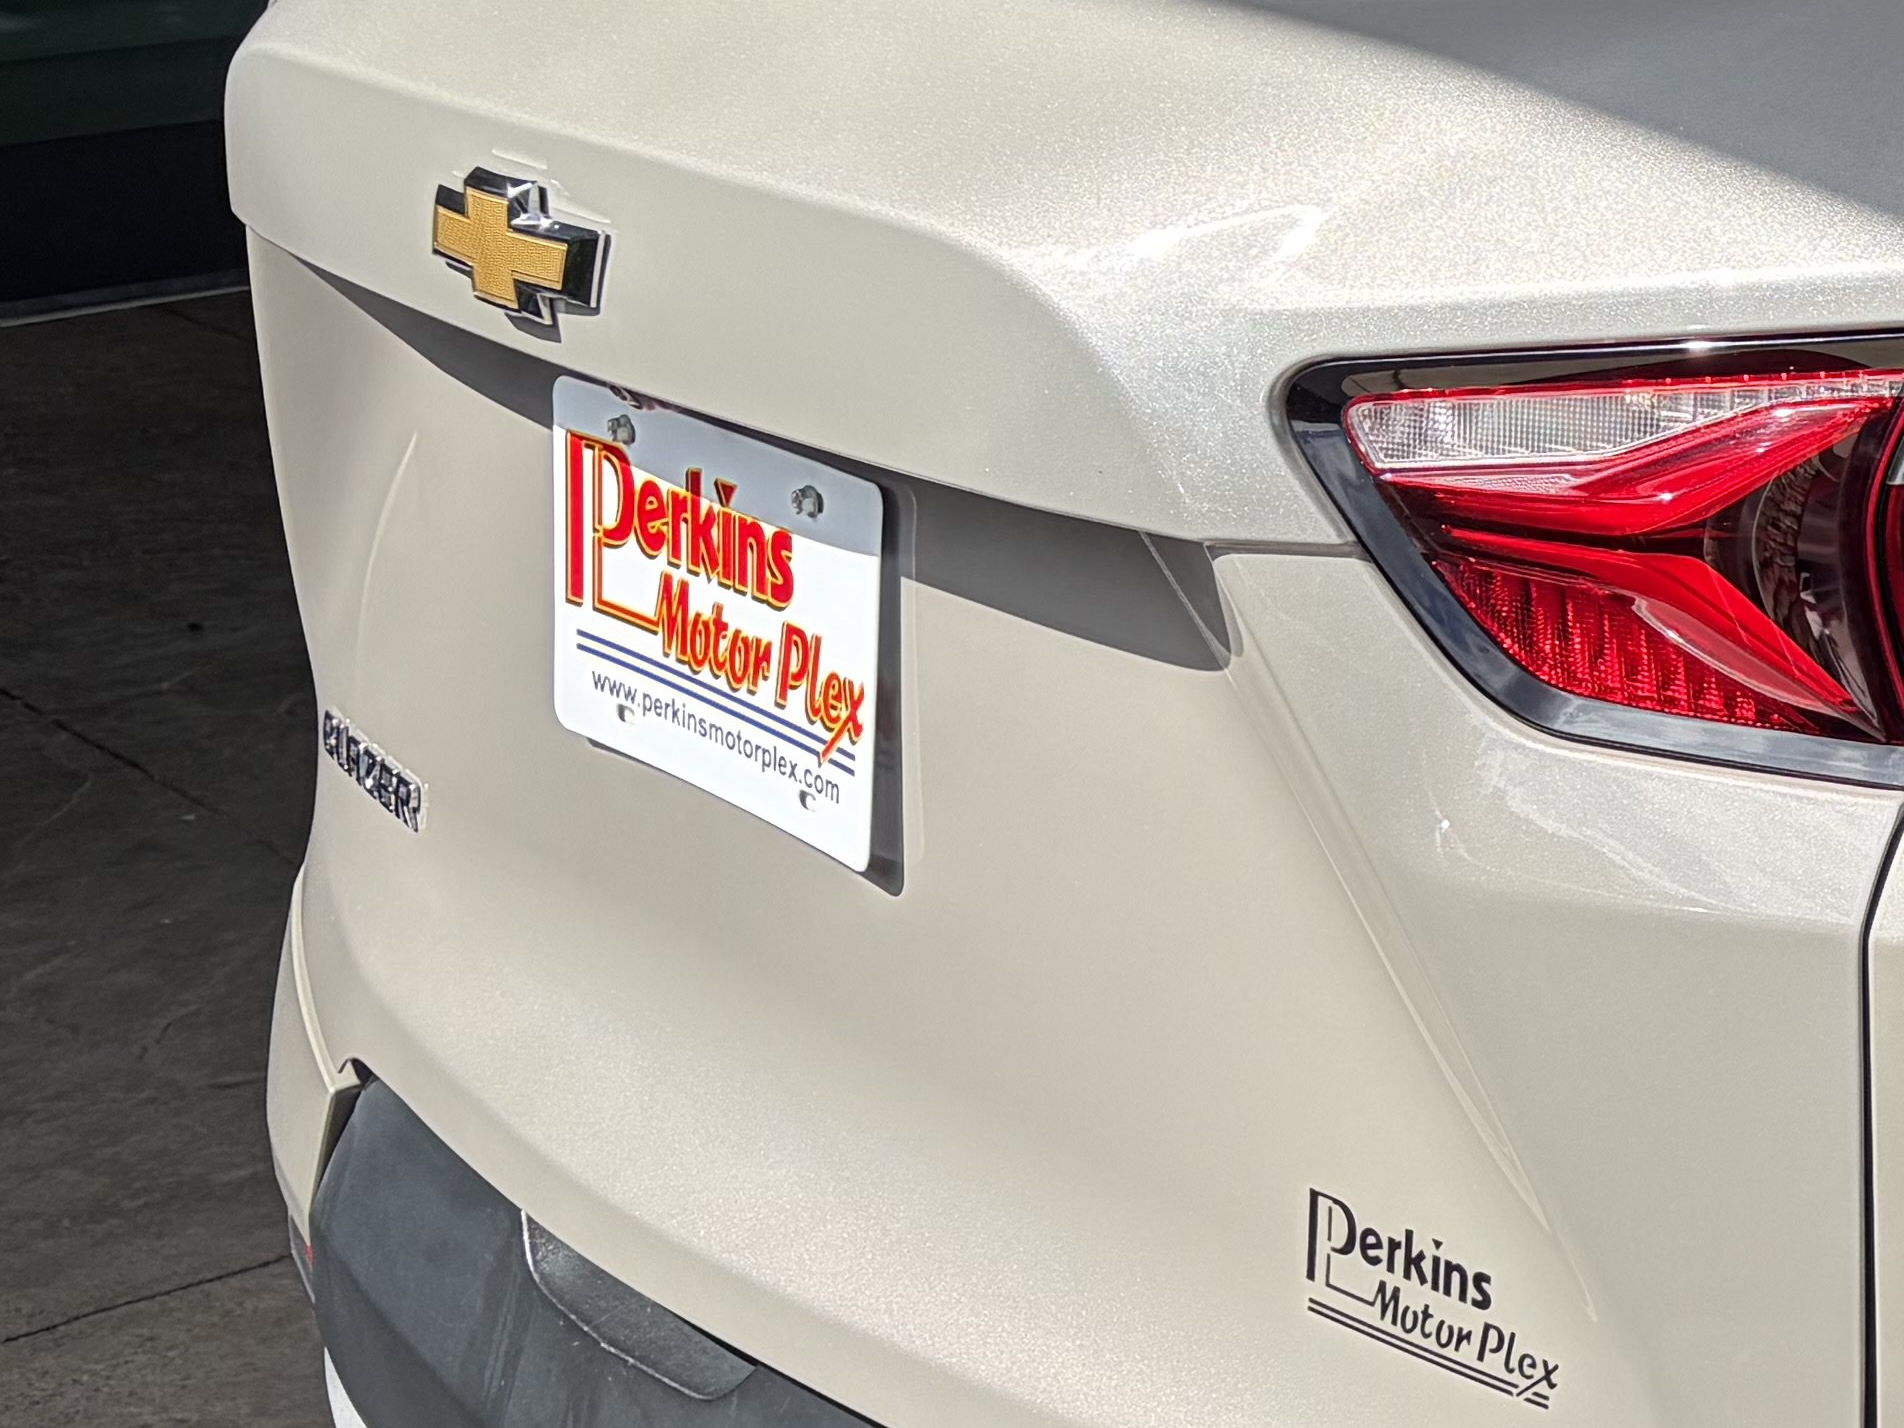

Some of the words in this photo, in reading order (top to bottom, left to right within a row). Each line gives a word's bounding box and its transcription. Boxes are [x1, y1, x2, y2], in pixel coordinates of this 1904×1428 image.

[565, 429, 795, 609] Perkins
[655, 571, 771, 695] Motor
[775, 619, 866, 767] Plex
[592, 670, 840, 804] www.perkinsmotorplex.com
[1306, 1186, 1492, 1311] Perkins
[1372, 1279, 1473, 1353] Motor
[1476, 1321, 1560, 1397] Plex
